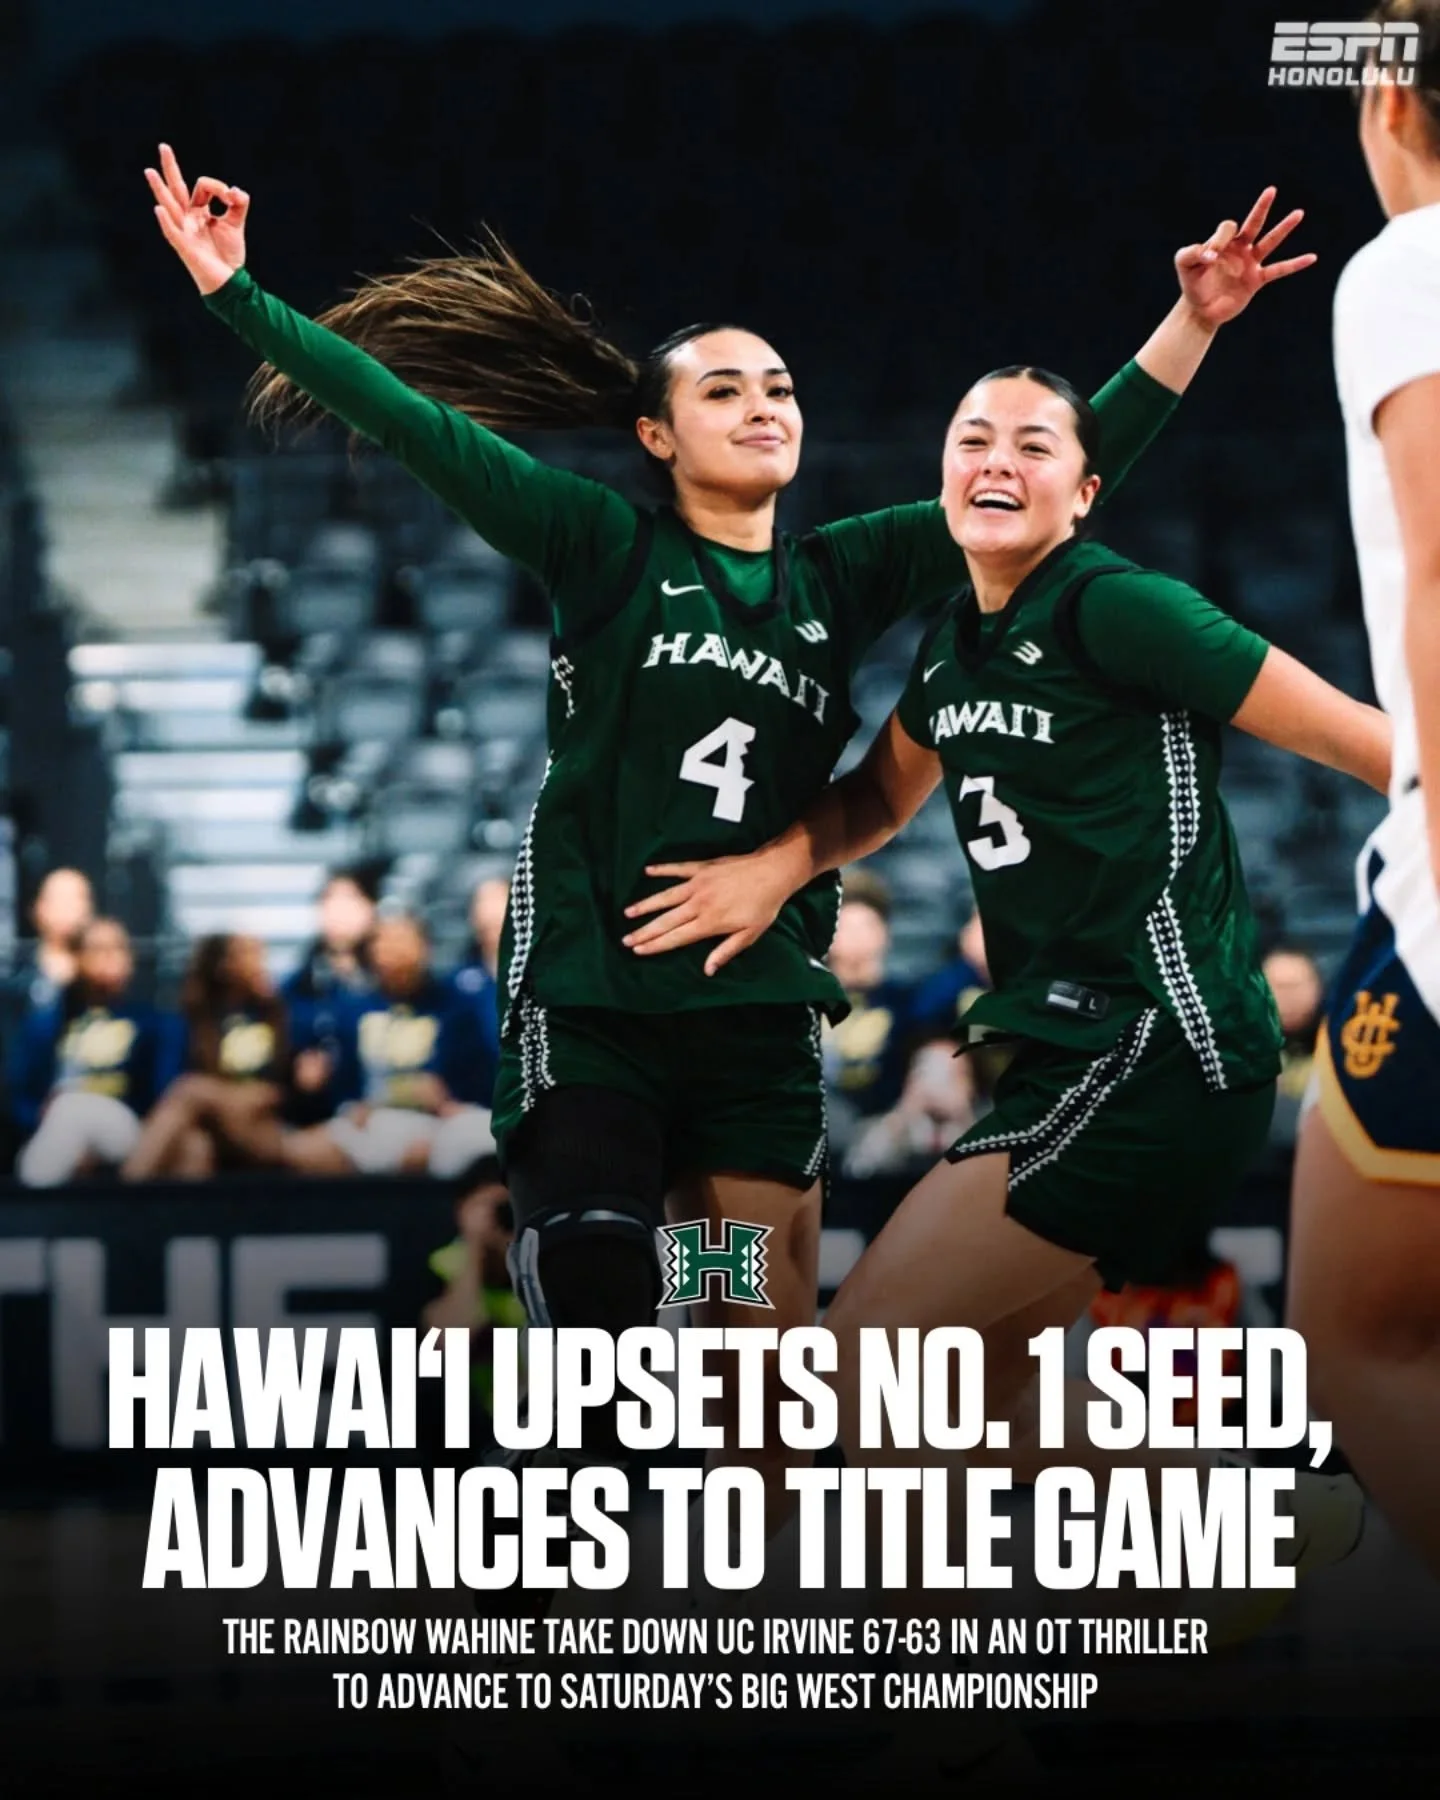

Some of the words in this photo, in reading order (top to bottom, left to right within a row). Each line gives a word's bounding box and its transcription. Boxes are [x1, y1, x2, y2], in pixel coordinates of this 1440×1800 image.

[679, 716, 757, 823] 4
[929, 700, 1056, 744] AWAI'I
[959, 775, 1031, 871] 3
